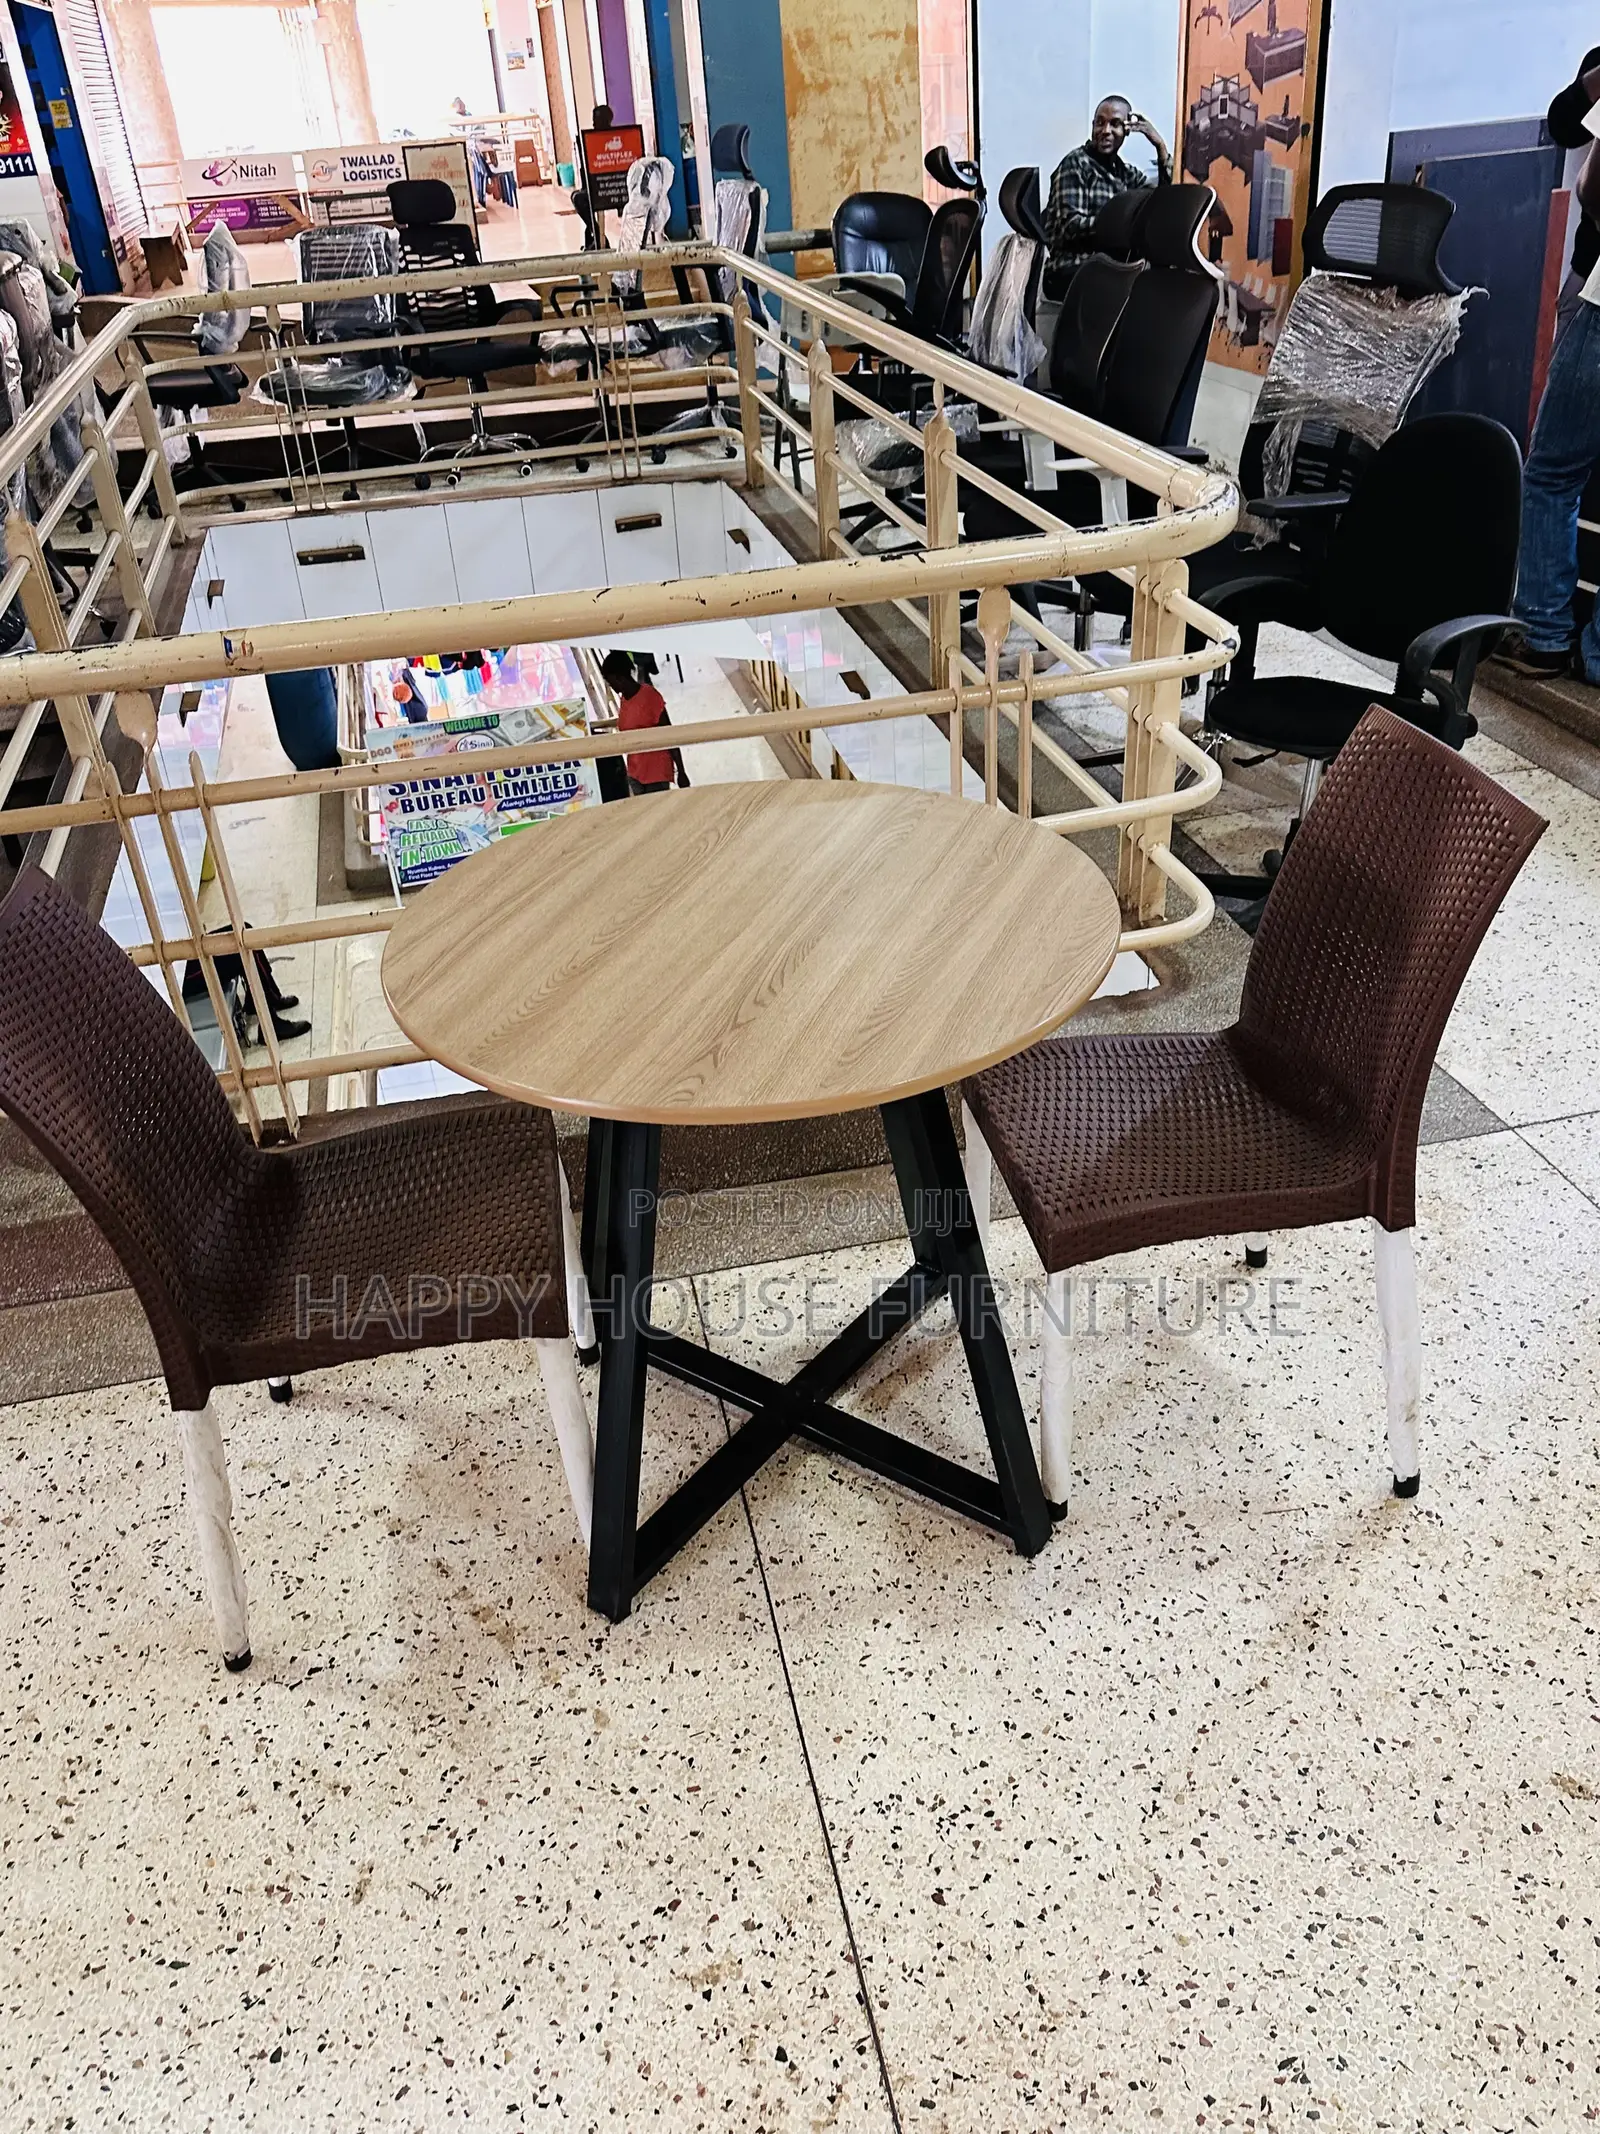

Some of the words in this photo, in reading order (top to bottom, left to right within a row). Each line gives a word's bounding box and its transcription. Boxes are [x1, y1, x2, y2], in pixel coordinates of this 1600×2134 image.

[340, 153, 395, 168] TWALLAD
[239, 163, 277, 178] Nitah
[343, 167, 402, 182] LOGISTICS
[445, 717, 487, 733] WELCOME
[487, 715, 498, 727] TO
[469, 739, 493, 749] Sinai
[400, 787, 485, 814] BUREAU
[493, 773, 577, 800] LIMITED
[501, 798, 525, 809] Always
[525, 796, 537, 804] the
[553, 792, 572, 801] Rates
[408, 819, 437, 831] FAST
[401, 828, 456, 847] RELIABLE
[402, 849, 421, 869] IN
[422, 841, 462, 862] TOWN
